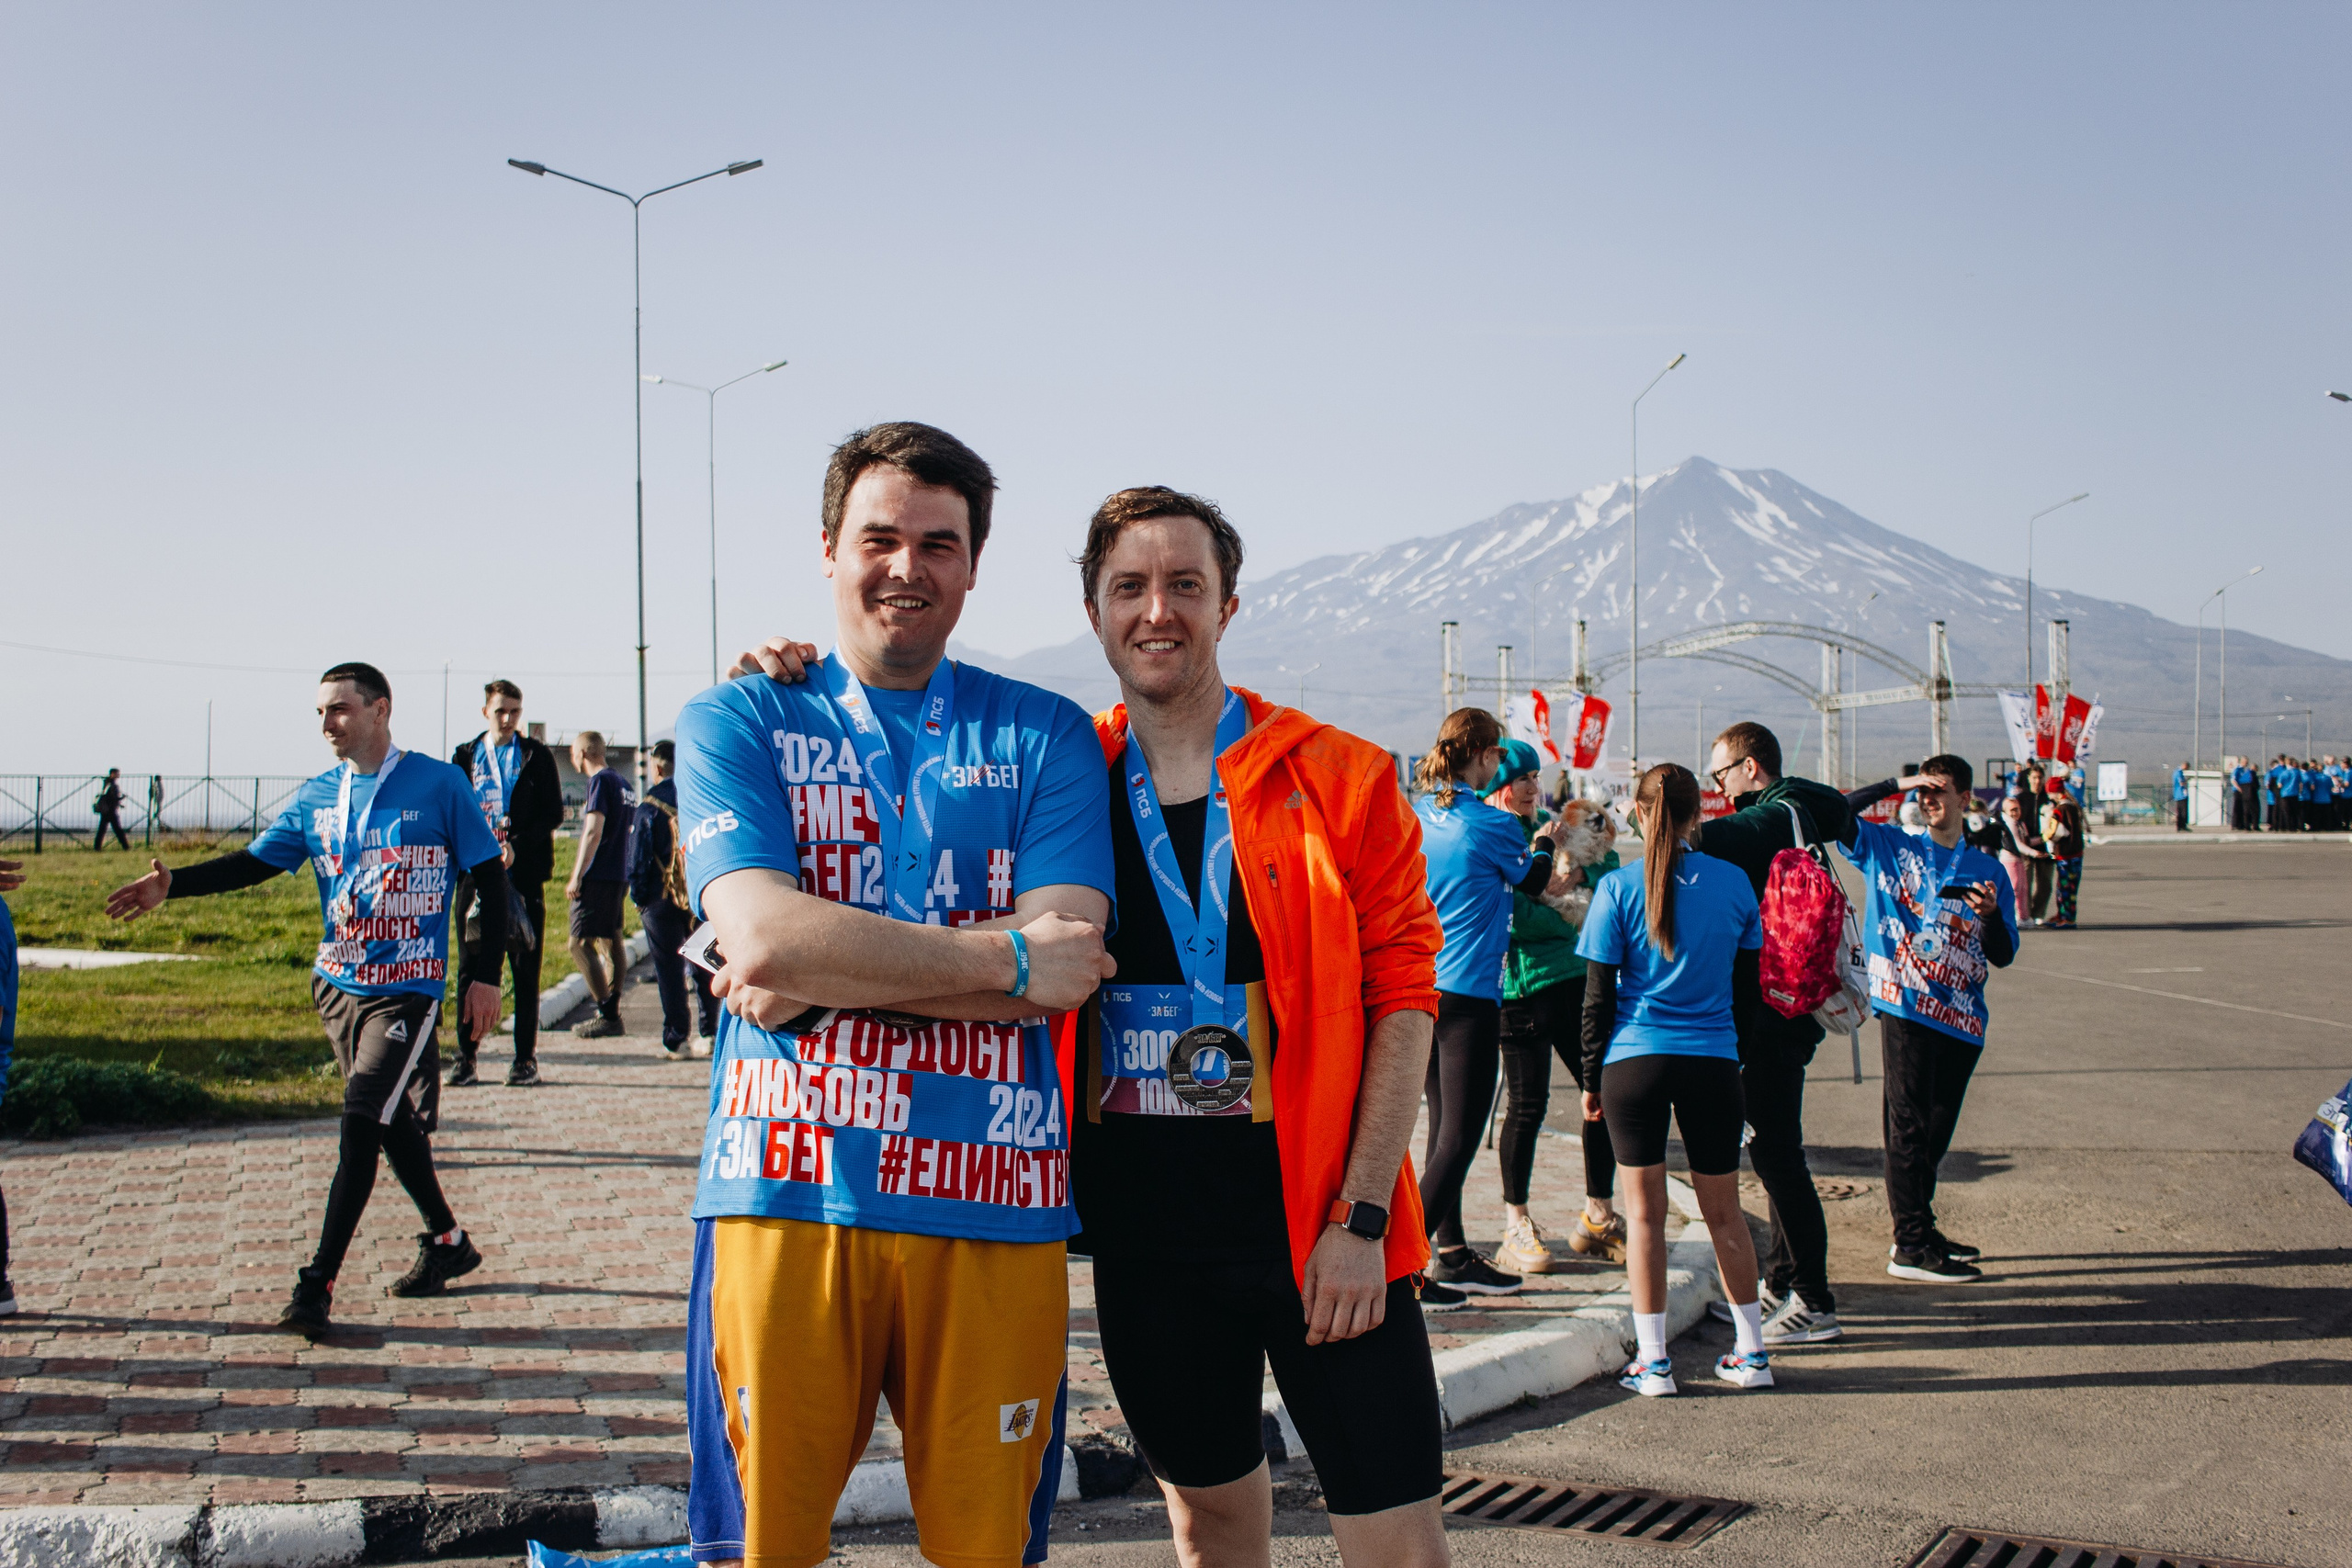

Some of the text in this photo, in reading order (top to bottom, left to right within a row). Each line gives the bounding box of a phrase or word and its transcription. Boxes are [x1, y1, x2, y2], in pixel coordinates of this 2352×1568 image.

[849, 708, 870, 734] ПСБ
[930, 696, 944, 721] ПСБ
[773, 728, 864, 785] 2024
[1135, 787, 1153, 819] ПСБ
[688, 810, 740, 854] ПСБ
[401, 845, 448, 868] #ЦЕЛЬ
[373, 892, 445, 917] #МОМЕН
[396, 937, 435, 963] 2024
[1113, 992, 1132, 1002] ПСБ
[1123, 1029, 1218, 1072] 3007
[721, 1059, 911, 1133] #ЛЮБОВЬ
[987, 1084, 1061, 1147] 2024
